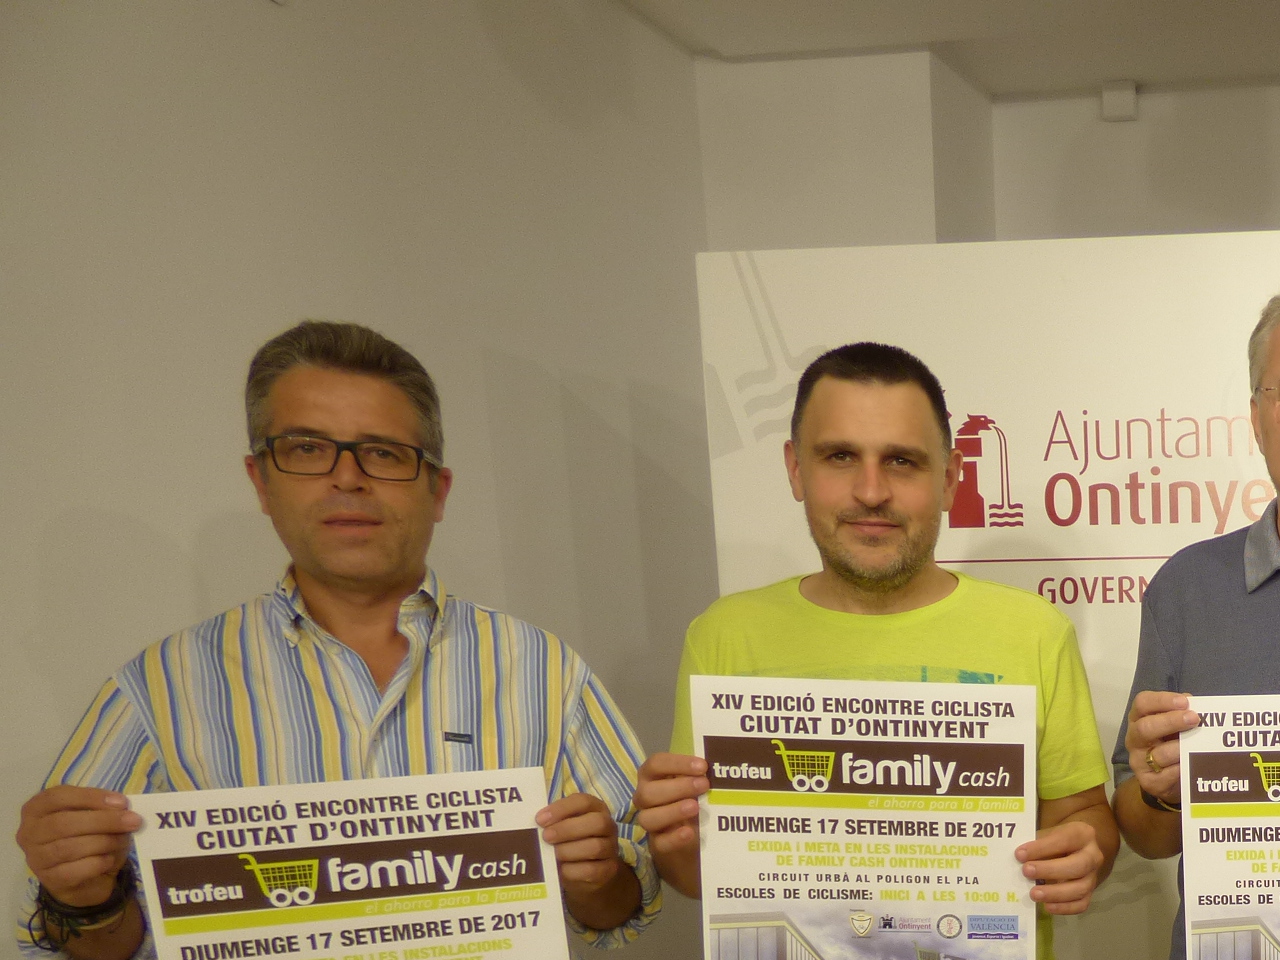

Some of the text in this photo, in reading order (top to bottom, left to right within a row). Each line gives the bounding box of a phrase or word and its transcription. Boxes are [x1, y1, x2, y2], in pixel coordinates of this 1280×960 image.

[1043, 407, 1254, 475] Ajuntam
[1044, 466, 1275, 534] Ontinye
[711, 693, 1014, 718] XIV EDICIÓ ENCONTRE CICLISTA
[740, 715, 988, 739] CIUTAT D'ONTINYENT
[1197, 712, 1226, 728] XIV
[713, 752, 1010, 794] trofeu family cash
[1196, 776, 1249, 792] trofeu
[155, 787, 523, 830] XIV EDICIÓ ENCONTRE CICLISTA
[197, 809, 495, 850] CIUTAT D'ONTINYENT
[718, 815, 1016, 838] DIUMENGE 17 SETEMBRE DE 2017
[1226, 850, 1266, 860] EIXIDA
[168, 850, 526, 905] trofeu family cash
[758, 872, 979, 885] CIRCUIT URBÀ AL POLIGON EL PLA
[1252, 863, 1267, 873] DE
[717, 887, 1019, 902] ESCOLES DE CICLISME: INICI A LES 10:00 H.
[1198, 894, 1251, 906] ESCOLES
[1258, 894, 1273, 904] DE
[306, 932, 332, 950] 17
[340, 919, 454, 947] SETEMBRE
[458, 916, 486, 935] DE
[491, 911, 540, 931] 2017
